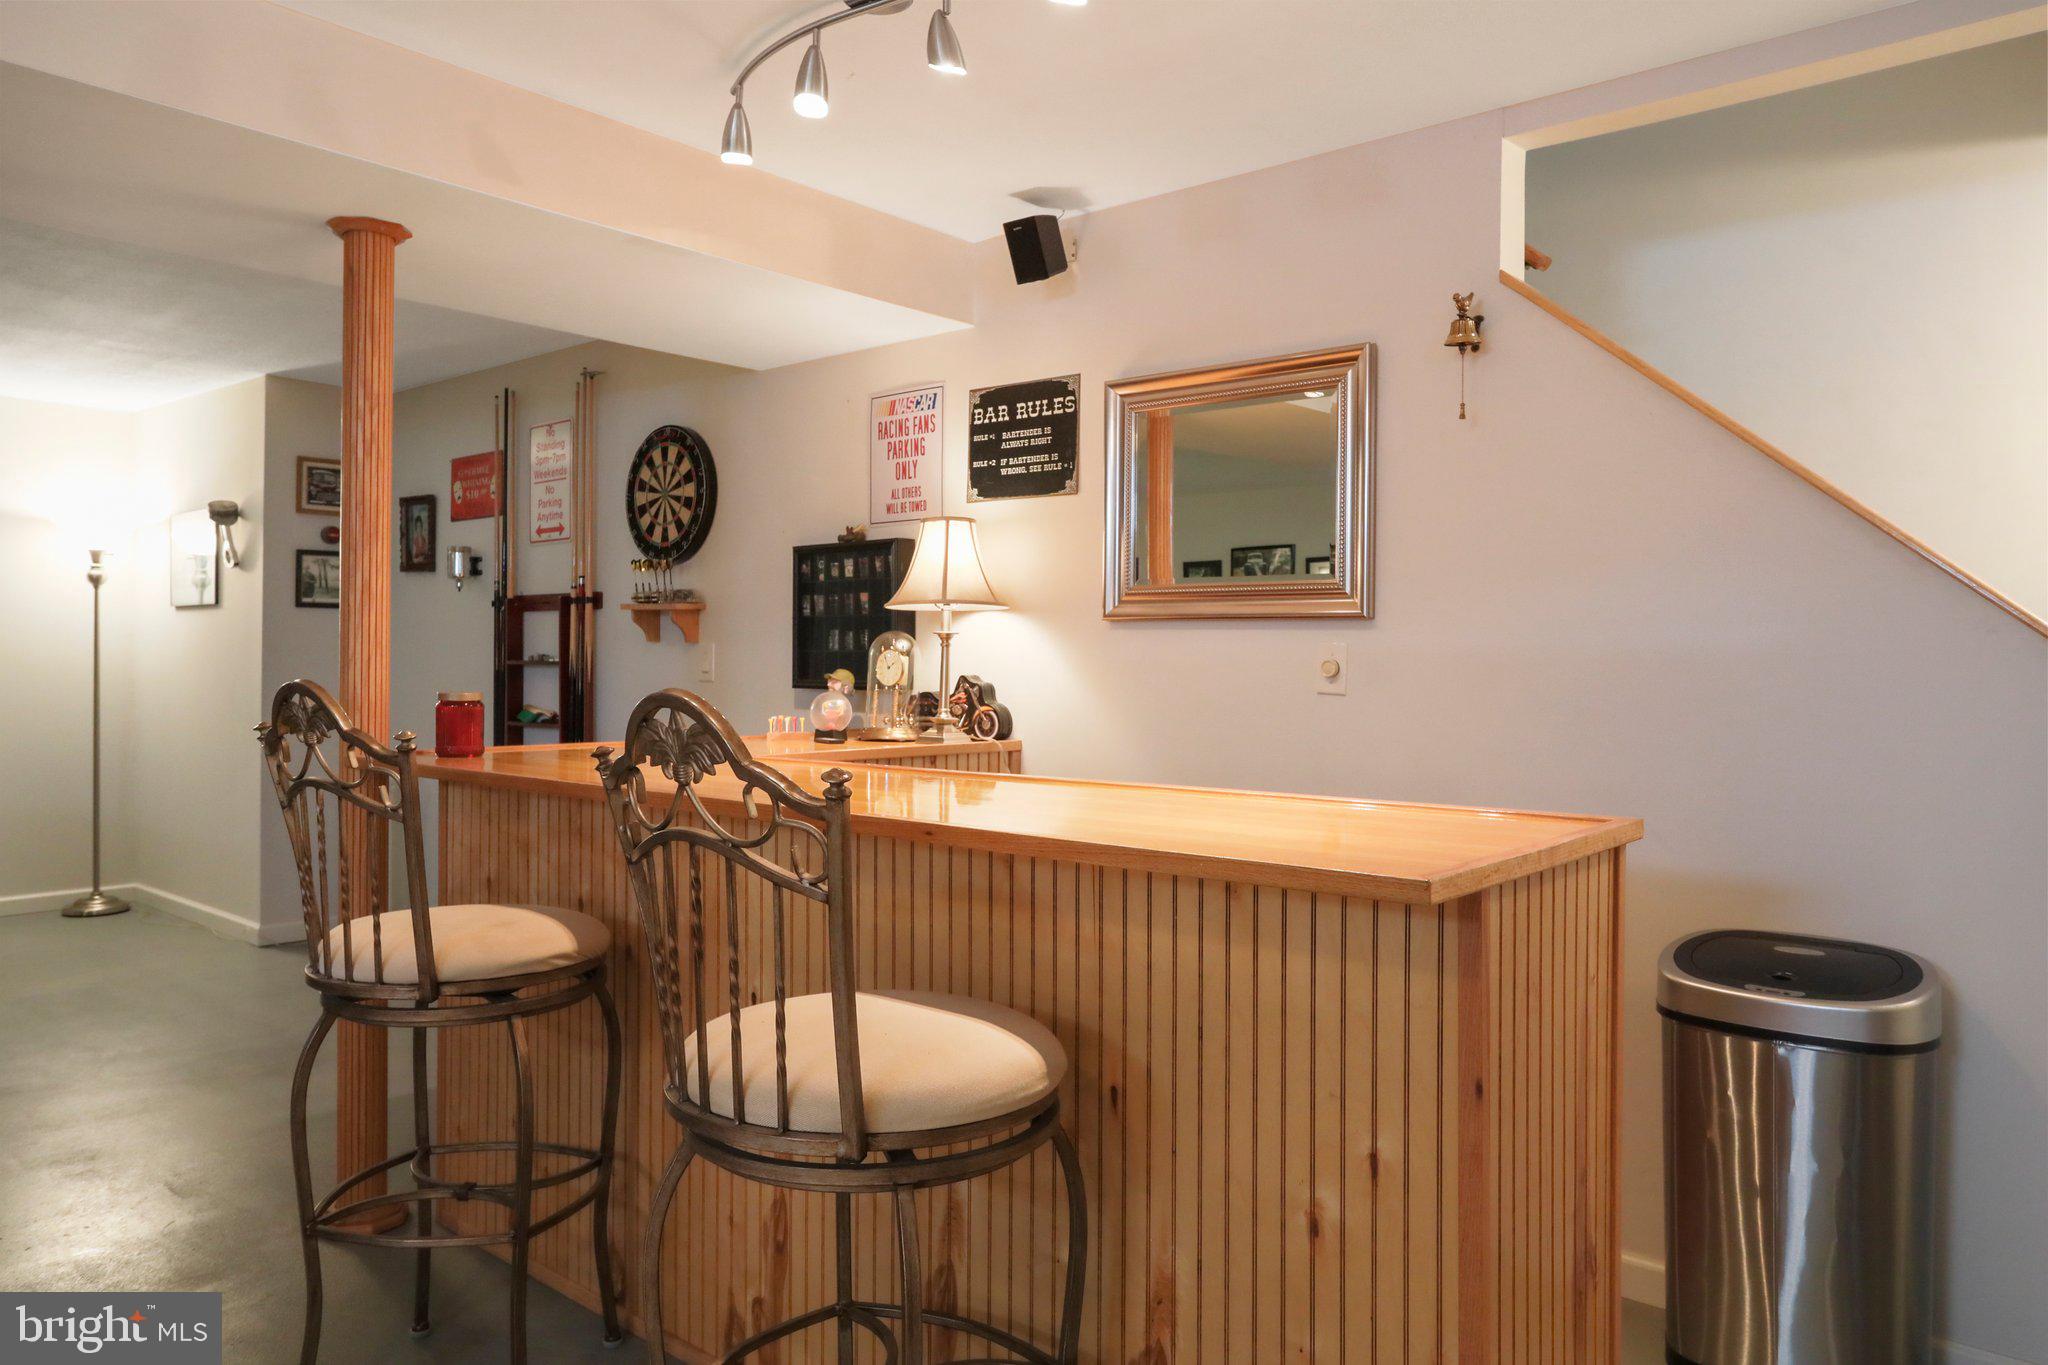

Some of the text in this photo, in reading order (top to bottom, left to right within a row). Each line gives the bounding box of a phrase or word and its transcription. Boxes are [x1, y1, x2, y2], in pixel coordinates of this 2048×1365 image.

[973, 396, 1076, 425] BAR RULES
[545, 428, 556, 438] No
[877, 413, 936, 441] RACING FANS
[973, 434, 989, 442] RULE
[1002, 427, 1043, 440] BARTENDER
[1044, 426, 1052, 434] IS
[535, 440, 565, 453] Standing
[887, 437, 926, 461] PARKING
[1000, 436, 1053, 449] ALWAYS RIGHT
[972, 460, 988, 468] RULE
[1000, 458, 1008, 466] IF
[1009, 454, 1050, 465] BARTENDER
[1051, 453, 1059, 461] IS
[532, 467, 568, 480] Weekends
[895, 459, 919, 481] ONLY
[1029, 464, 1042, 473] SEE
[1043, 462, 1062, 471] RULE
[545, 485, 555, 495] No
[891, 486, 922, 500] ALL OTHERS
[538, 498, 562, 509] Parking
[886, 499, 928, 515] WILL BE TOWED
[537, 511, 563, 522] Anytime
